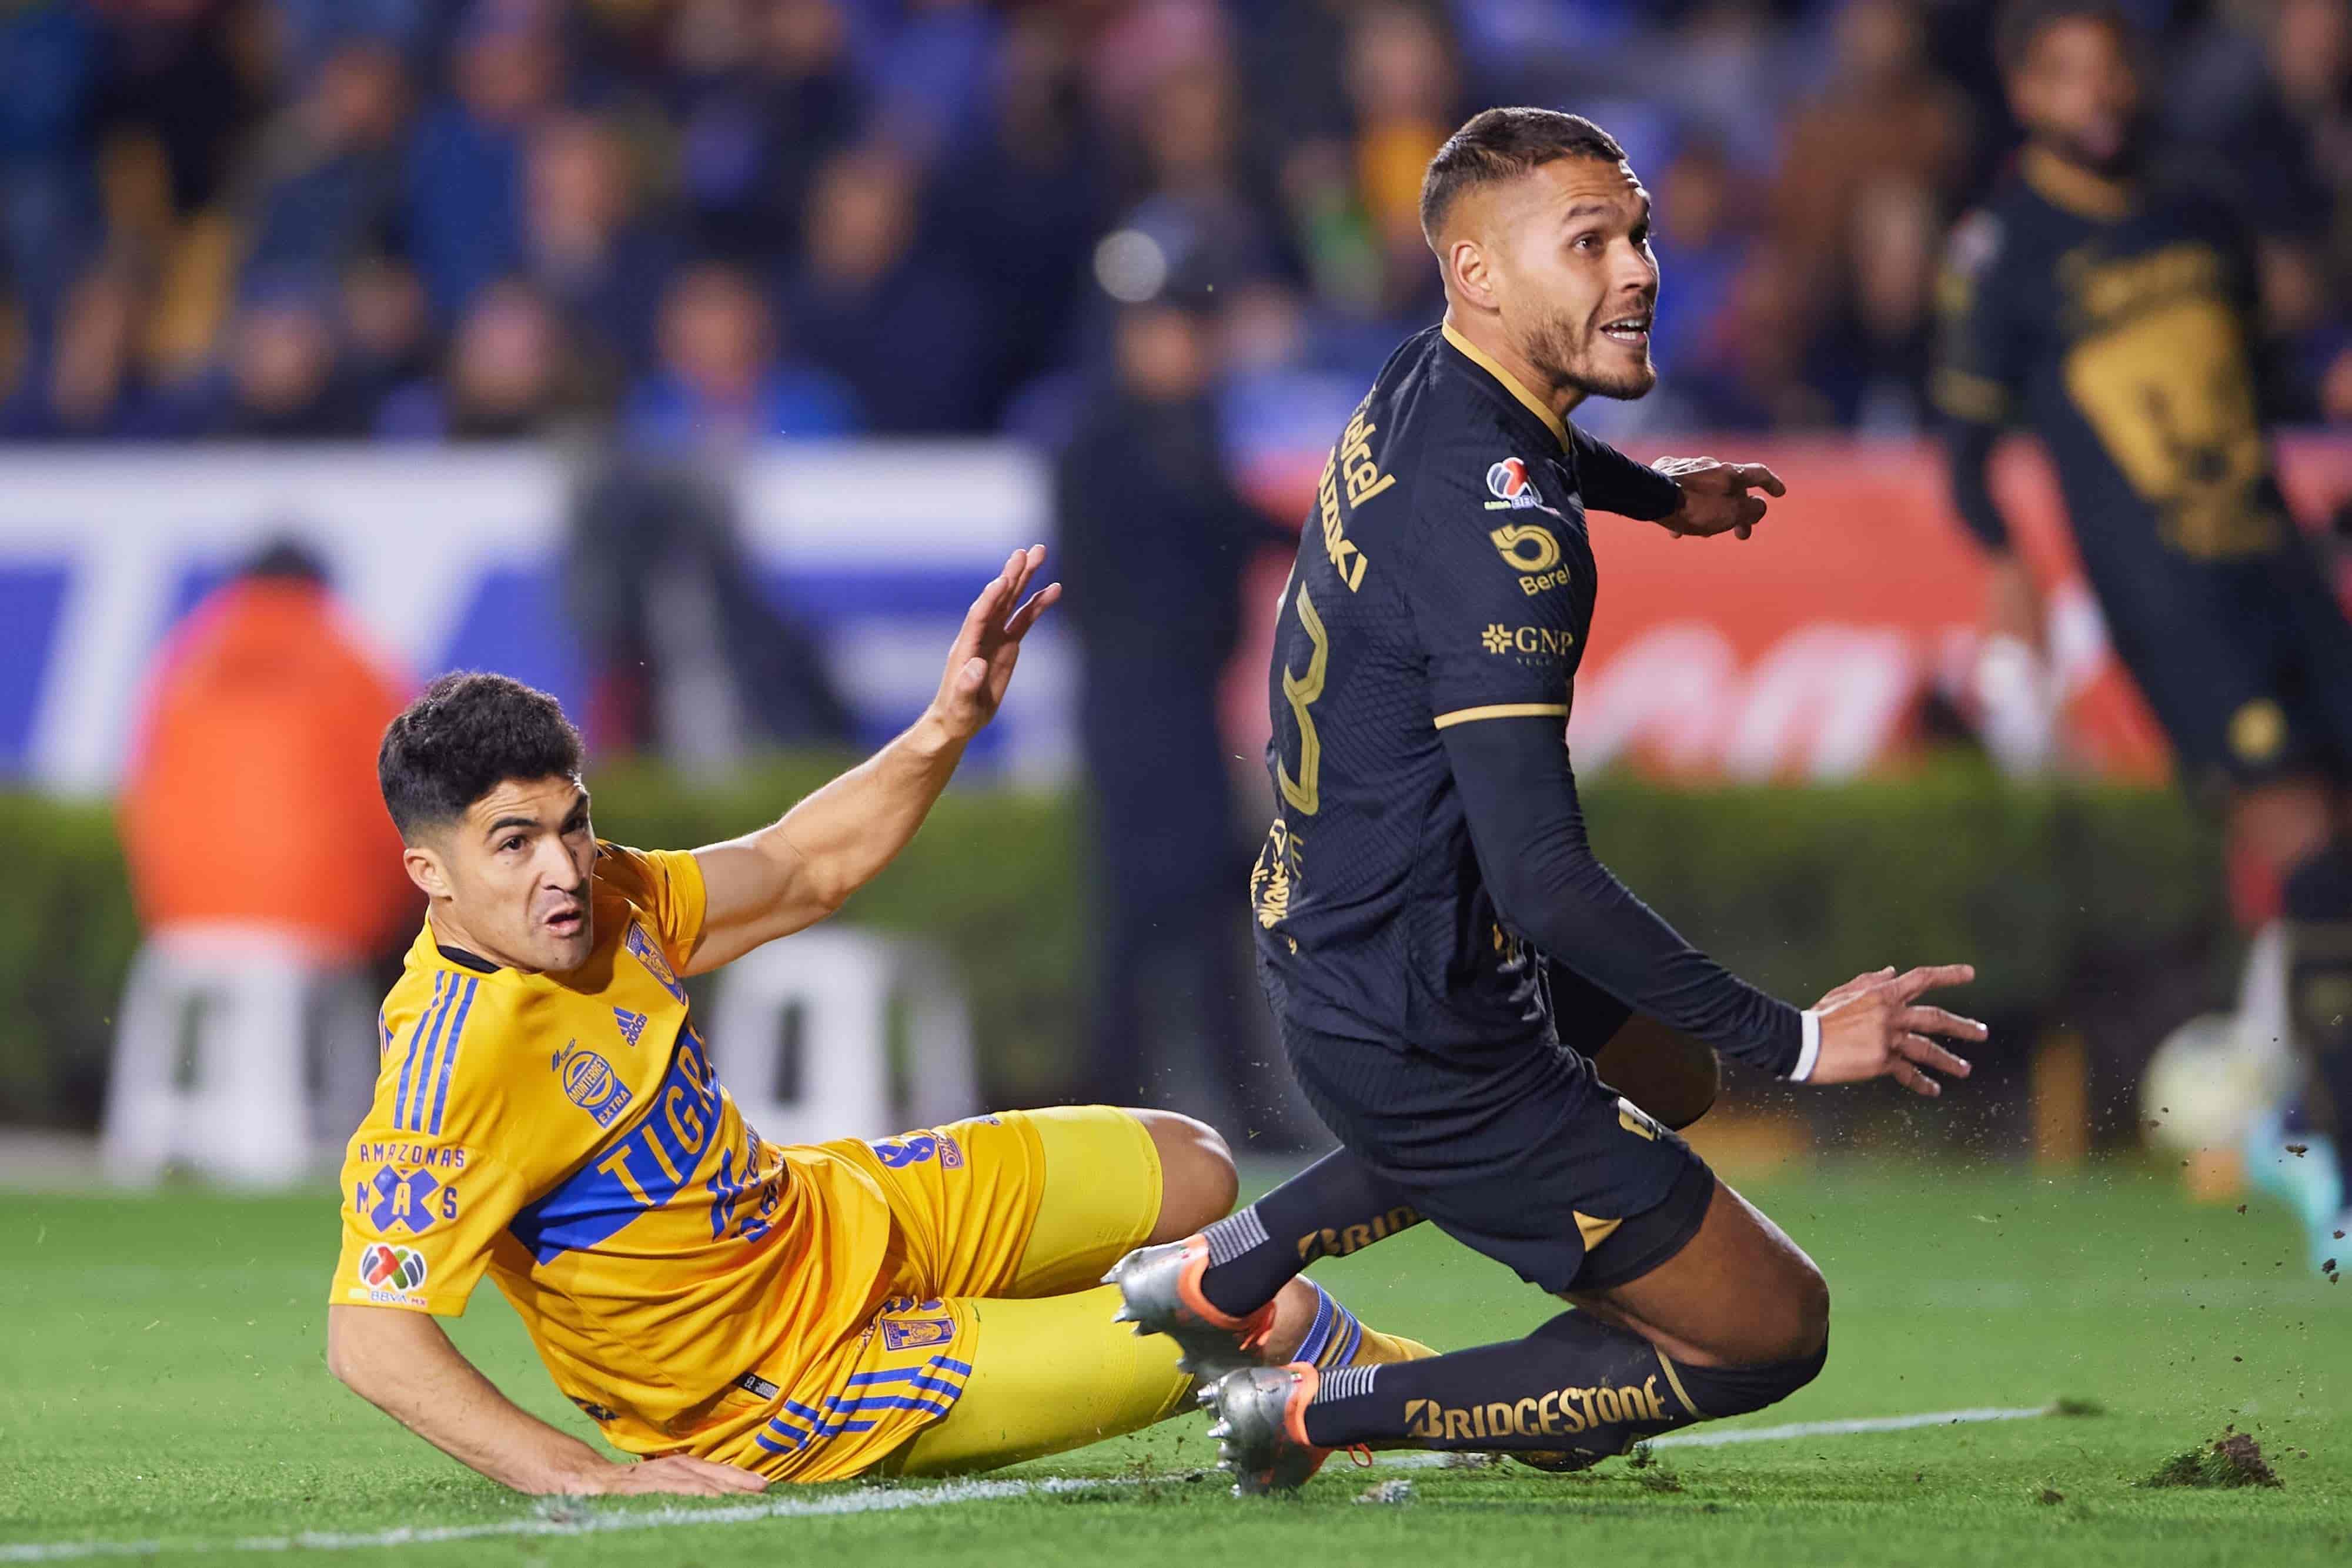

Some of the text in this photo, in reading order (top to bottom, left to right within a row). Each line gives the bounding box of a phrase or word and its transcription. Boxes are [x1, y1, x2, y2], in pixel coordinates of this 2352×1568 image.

[1519, 563, 1571, 597] Berel
[1515, 626, 1574, 656] GNP
[626, 1012, 648, 1047] adidas
[597, 1089, 630, 1123] EXTRA
[597, 1045, 715, 1207] TIGR
[360, 1143, 465, 1168] AMAZONAS
[1404, 1373, 1668, 1440] BRIDGESTONE
